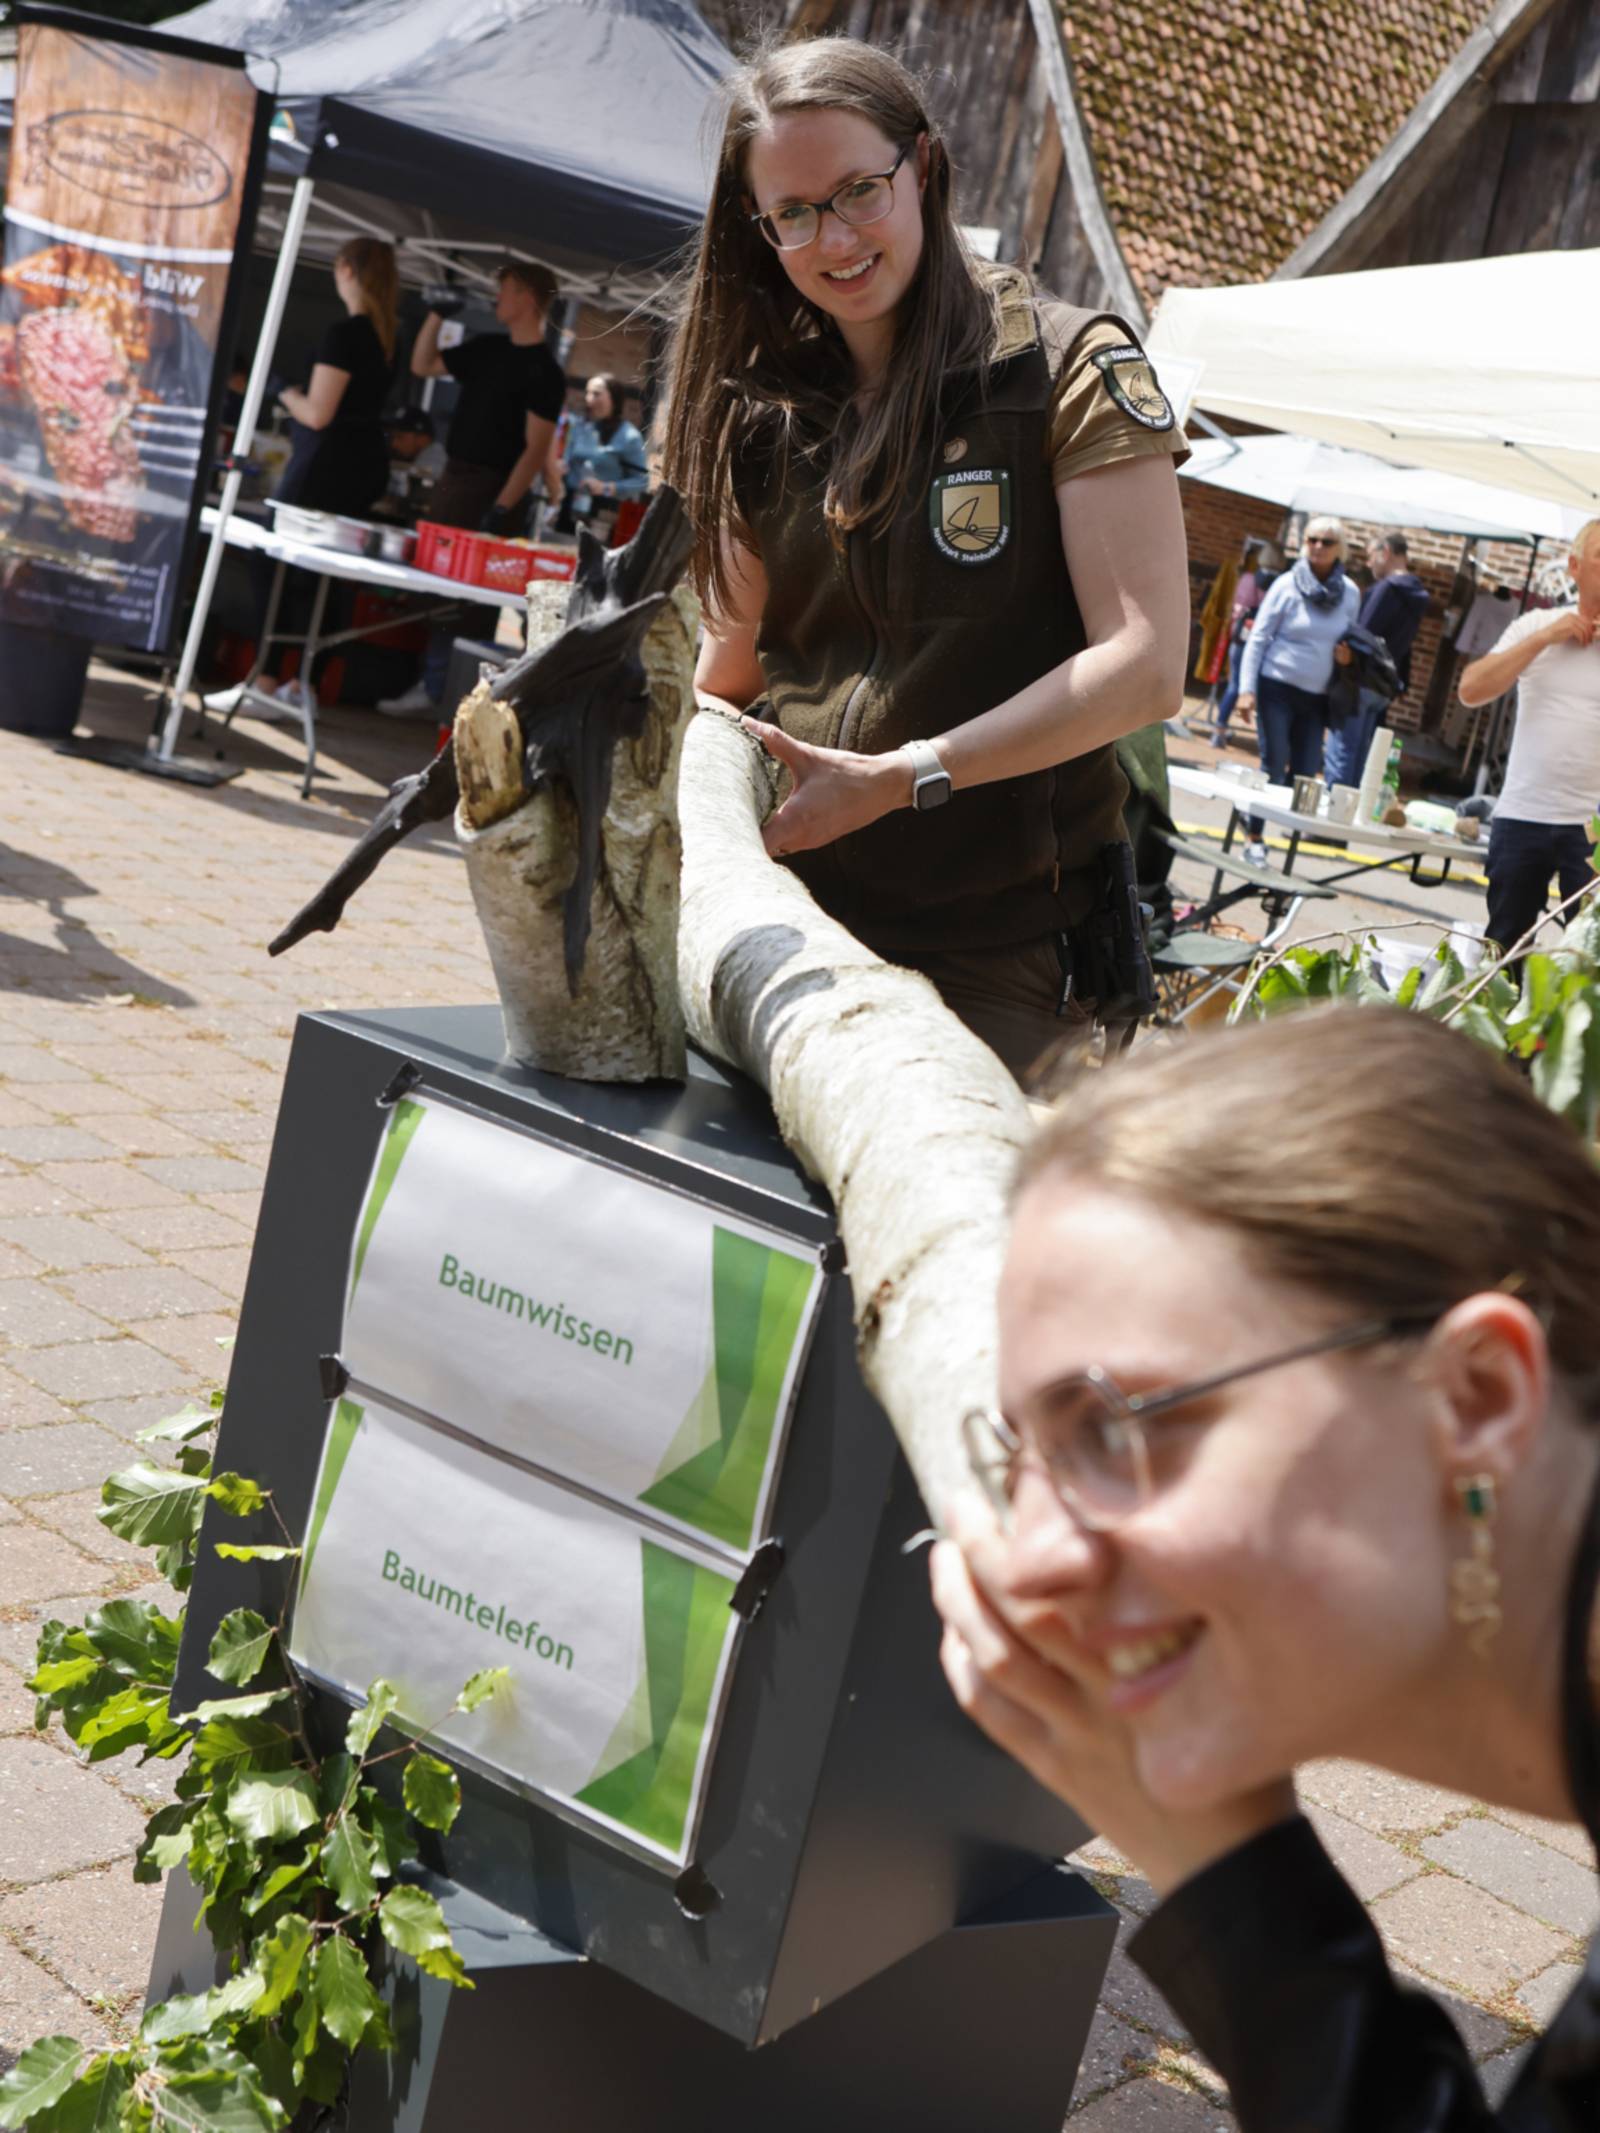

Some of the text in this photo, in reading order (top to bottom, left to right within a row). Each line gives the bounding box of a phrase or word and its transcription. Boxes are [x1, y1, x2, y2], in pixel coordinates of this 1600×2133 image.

[947, 469, 993, 485] RANGER
[438, 1253, 635, 1366] Baumwissen
[381, 1549, 575, 1671] Baumtelefon
